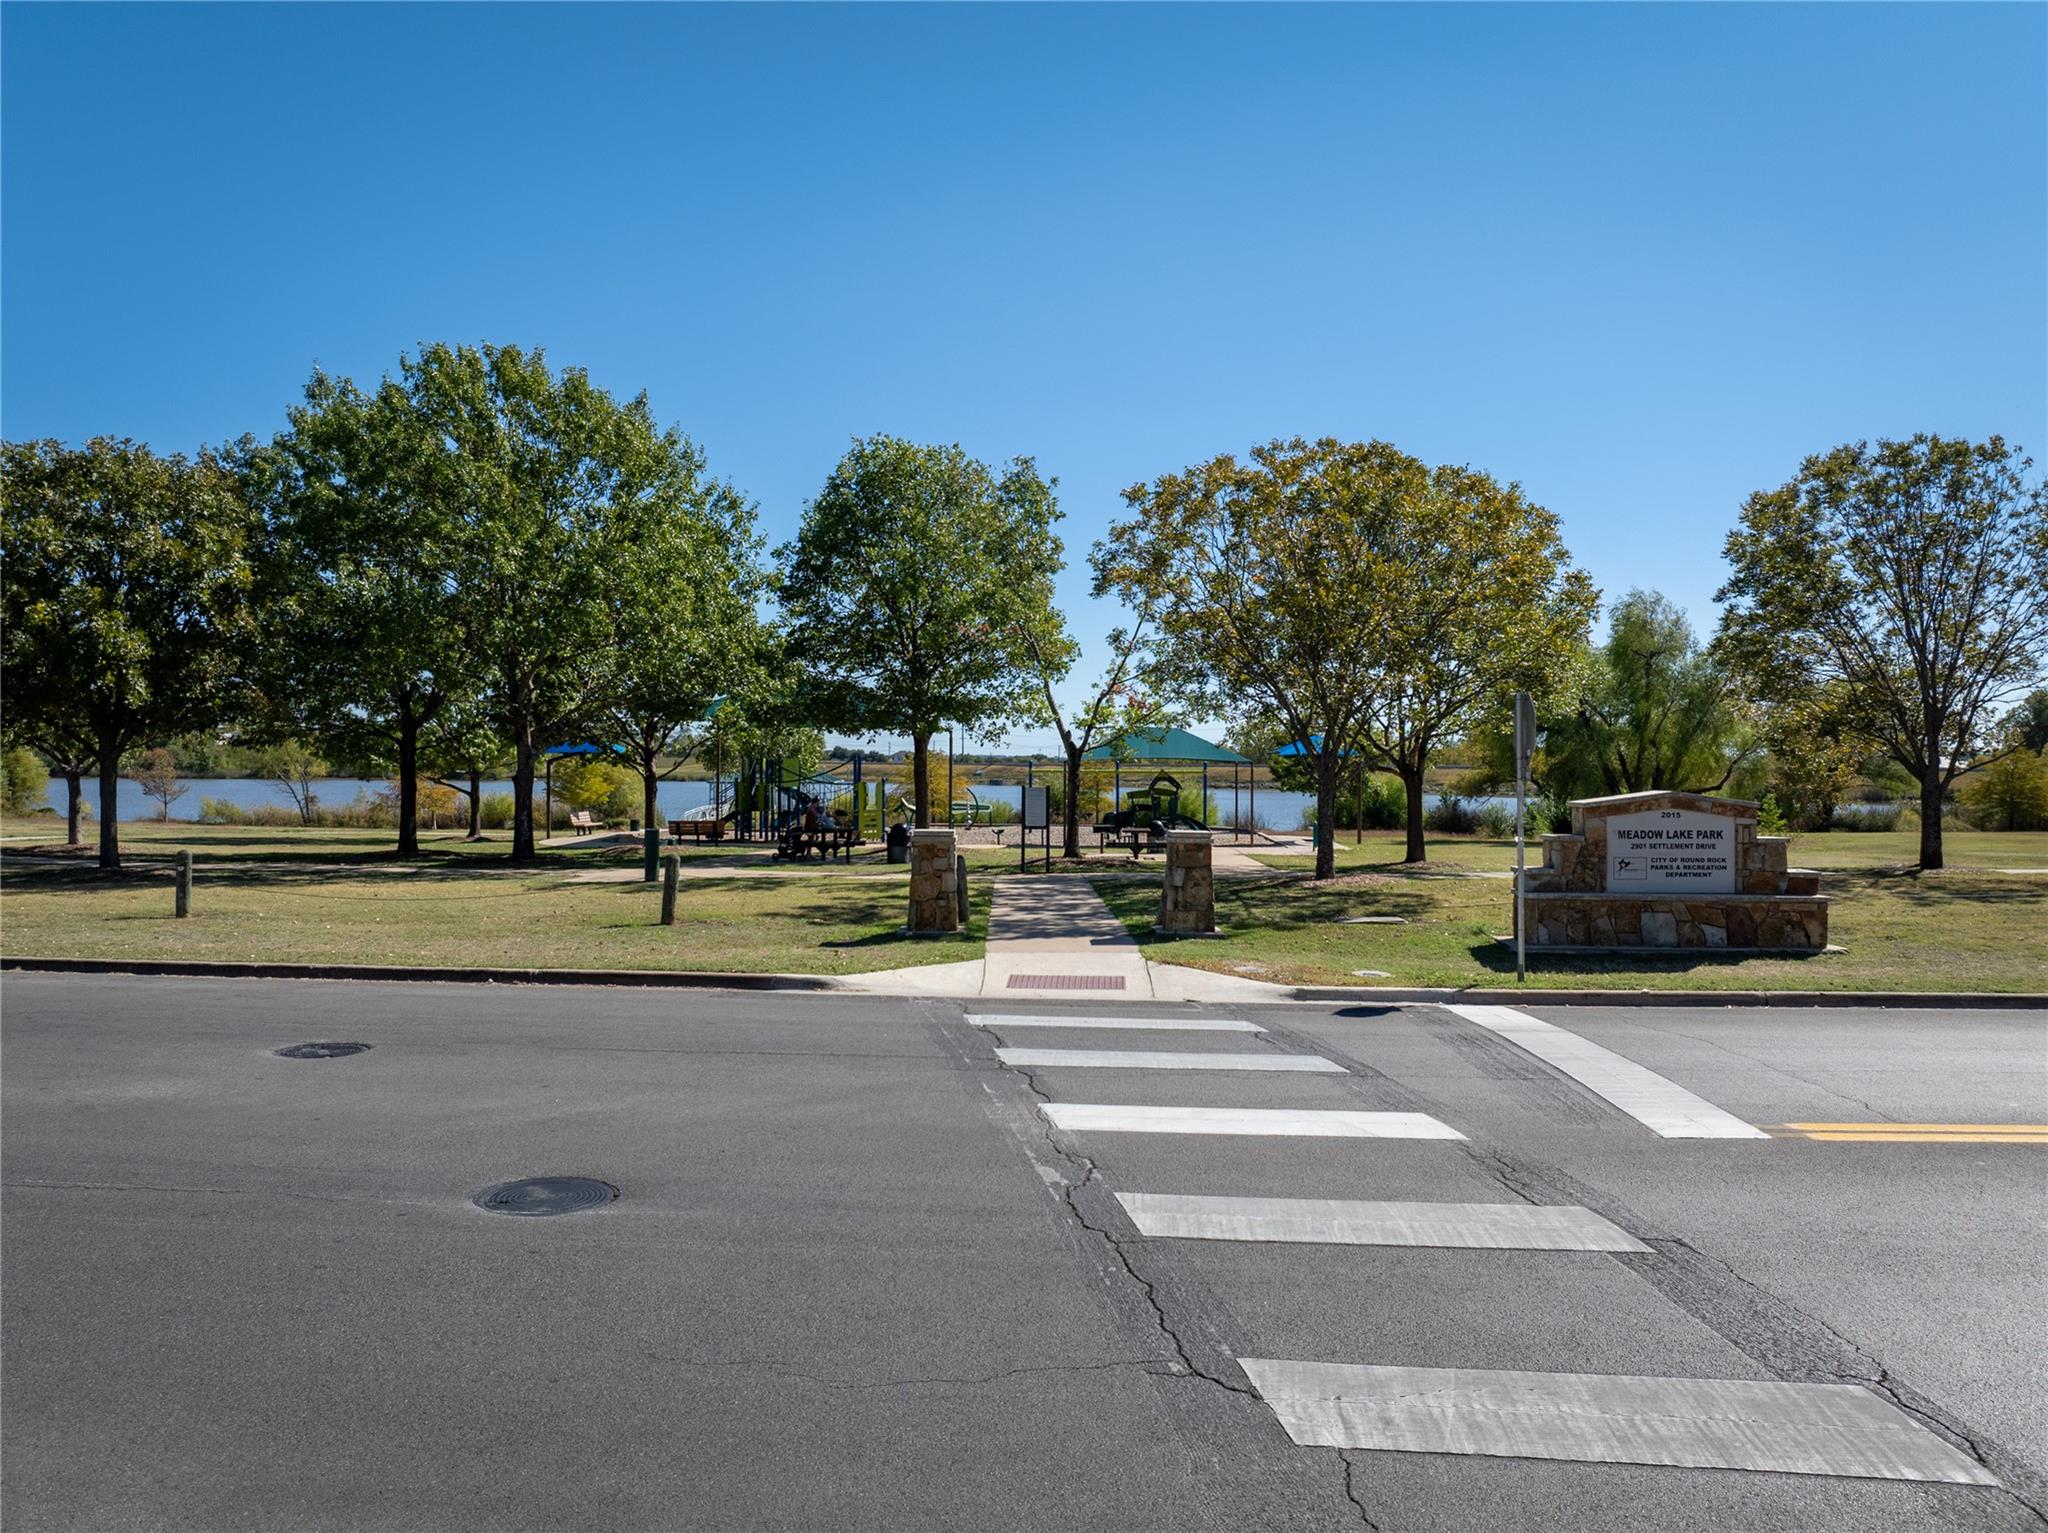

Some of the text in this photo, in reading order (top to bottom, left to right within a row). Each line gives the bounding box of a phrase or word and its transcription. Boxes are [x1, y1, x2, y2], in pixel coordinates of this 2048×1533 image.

[1617, 830, 1724, 839] MEADOW LAKE PARK
